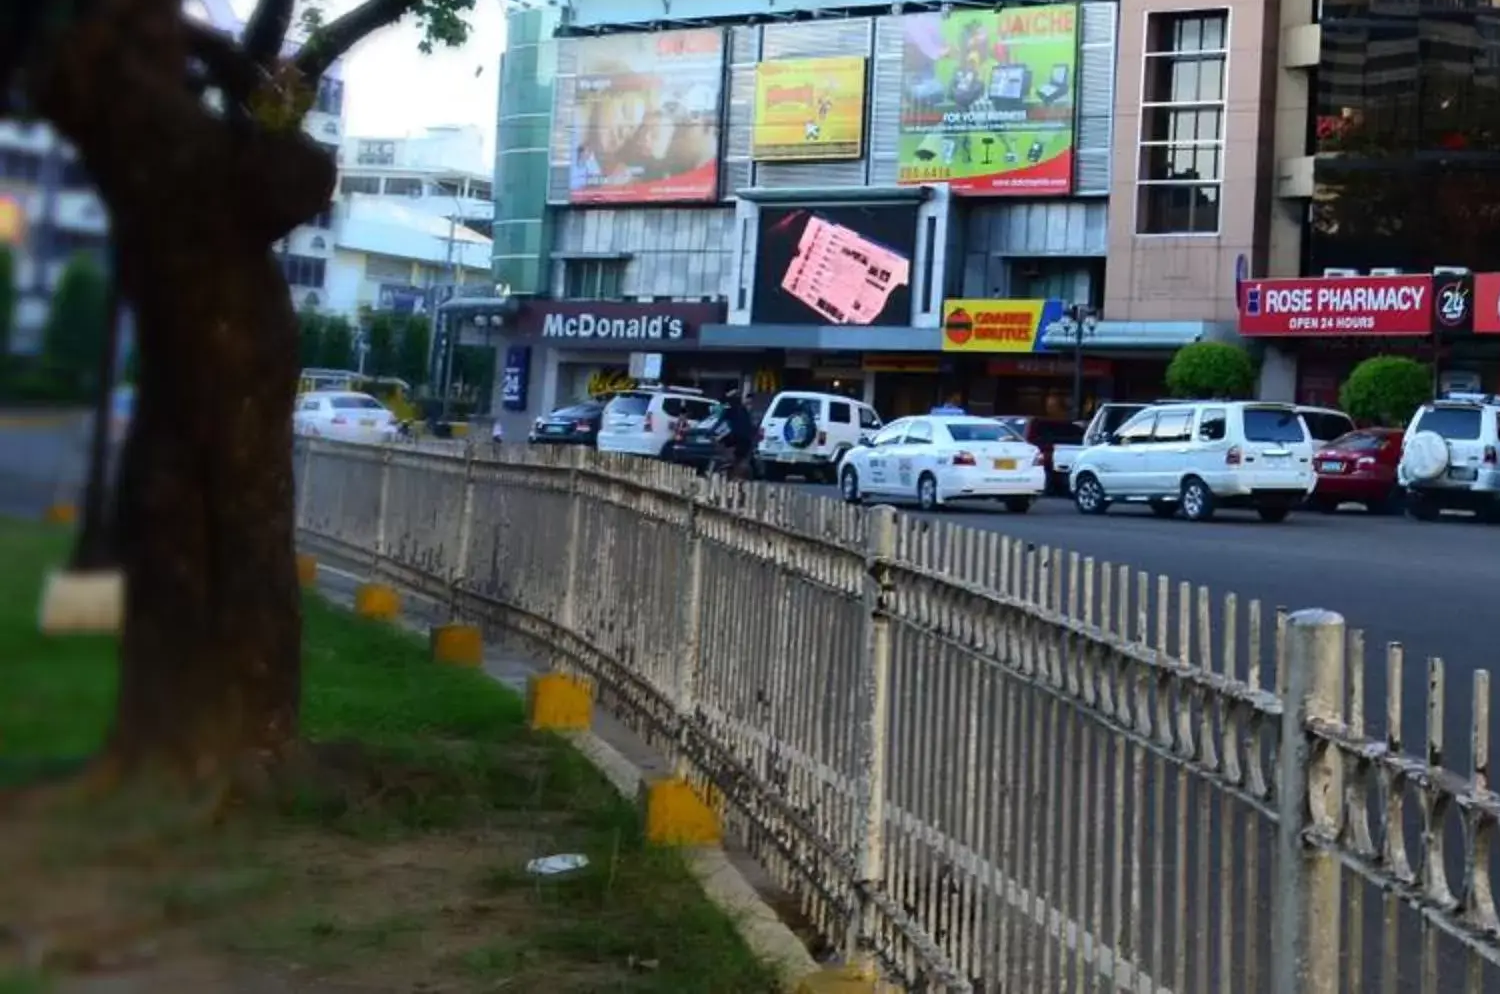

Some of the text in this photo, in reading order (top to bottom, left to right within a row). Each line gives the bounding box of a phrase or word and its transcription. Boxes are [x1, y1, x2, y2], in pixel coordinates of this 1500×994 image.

[1266, 286, 1424, 313] ROSE PHARMACY
[543, 313, 683, 339] McDonald's
[1289, 316, 1375, 329] OPEN 24 HOURS
